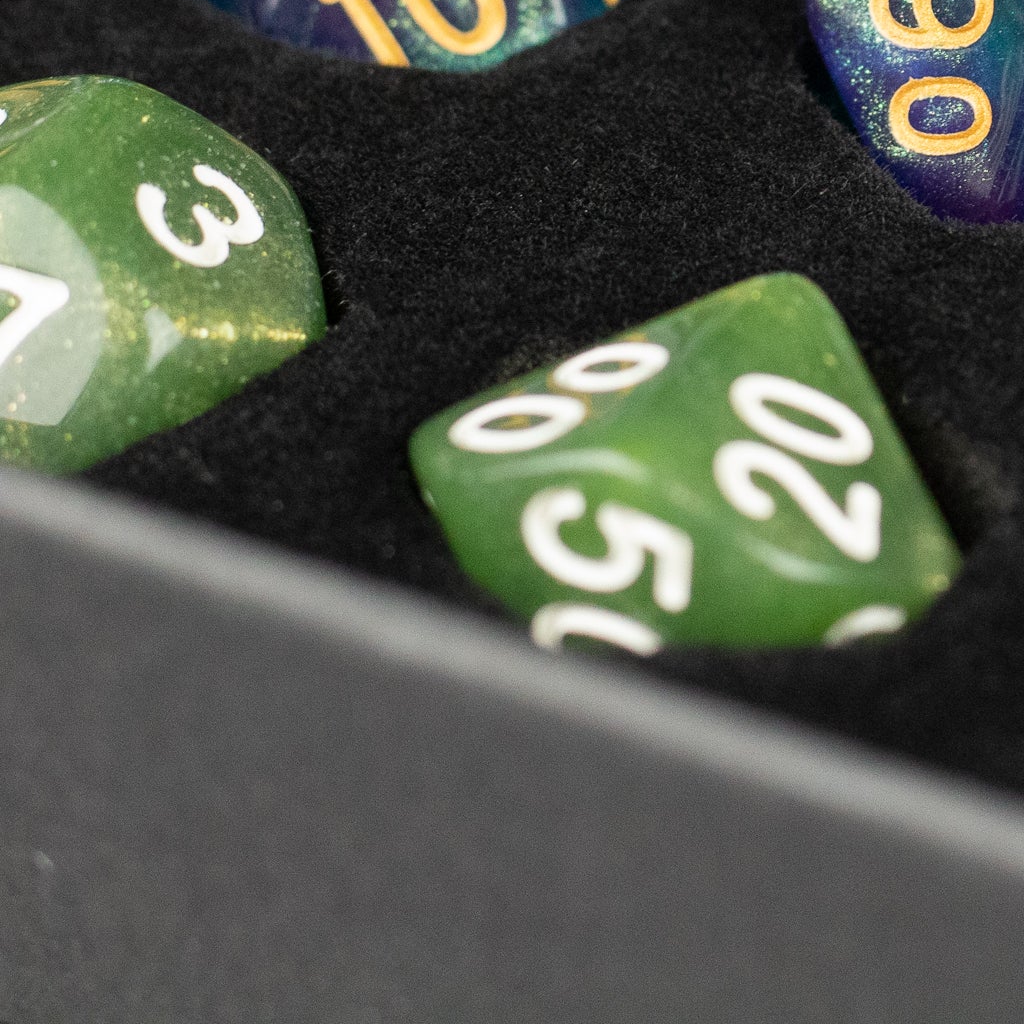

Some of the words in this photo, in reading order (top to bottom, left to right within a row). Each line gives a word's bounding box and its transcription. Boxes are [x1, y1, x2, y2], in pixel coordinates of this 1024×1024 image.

[134, 162, 266, 269] 3
[447, 340, 671, 454] 00
[712, 371, 882, 564] 20
